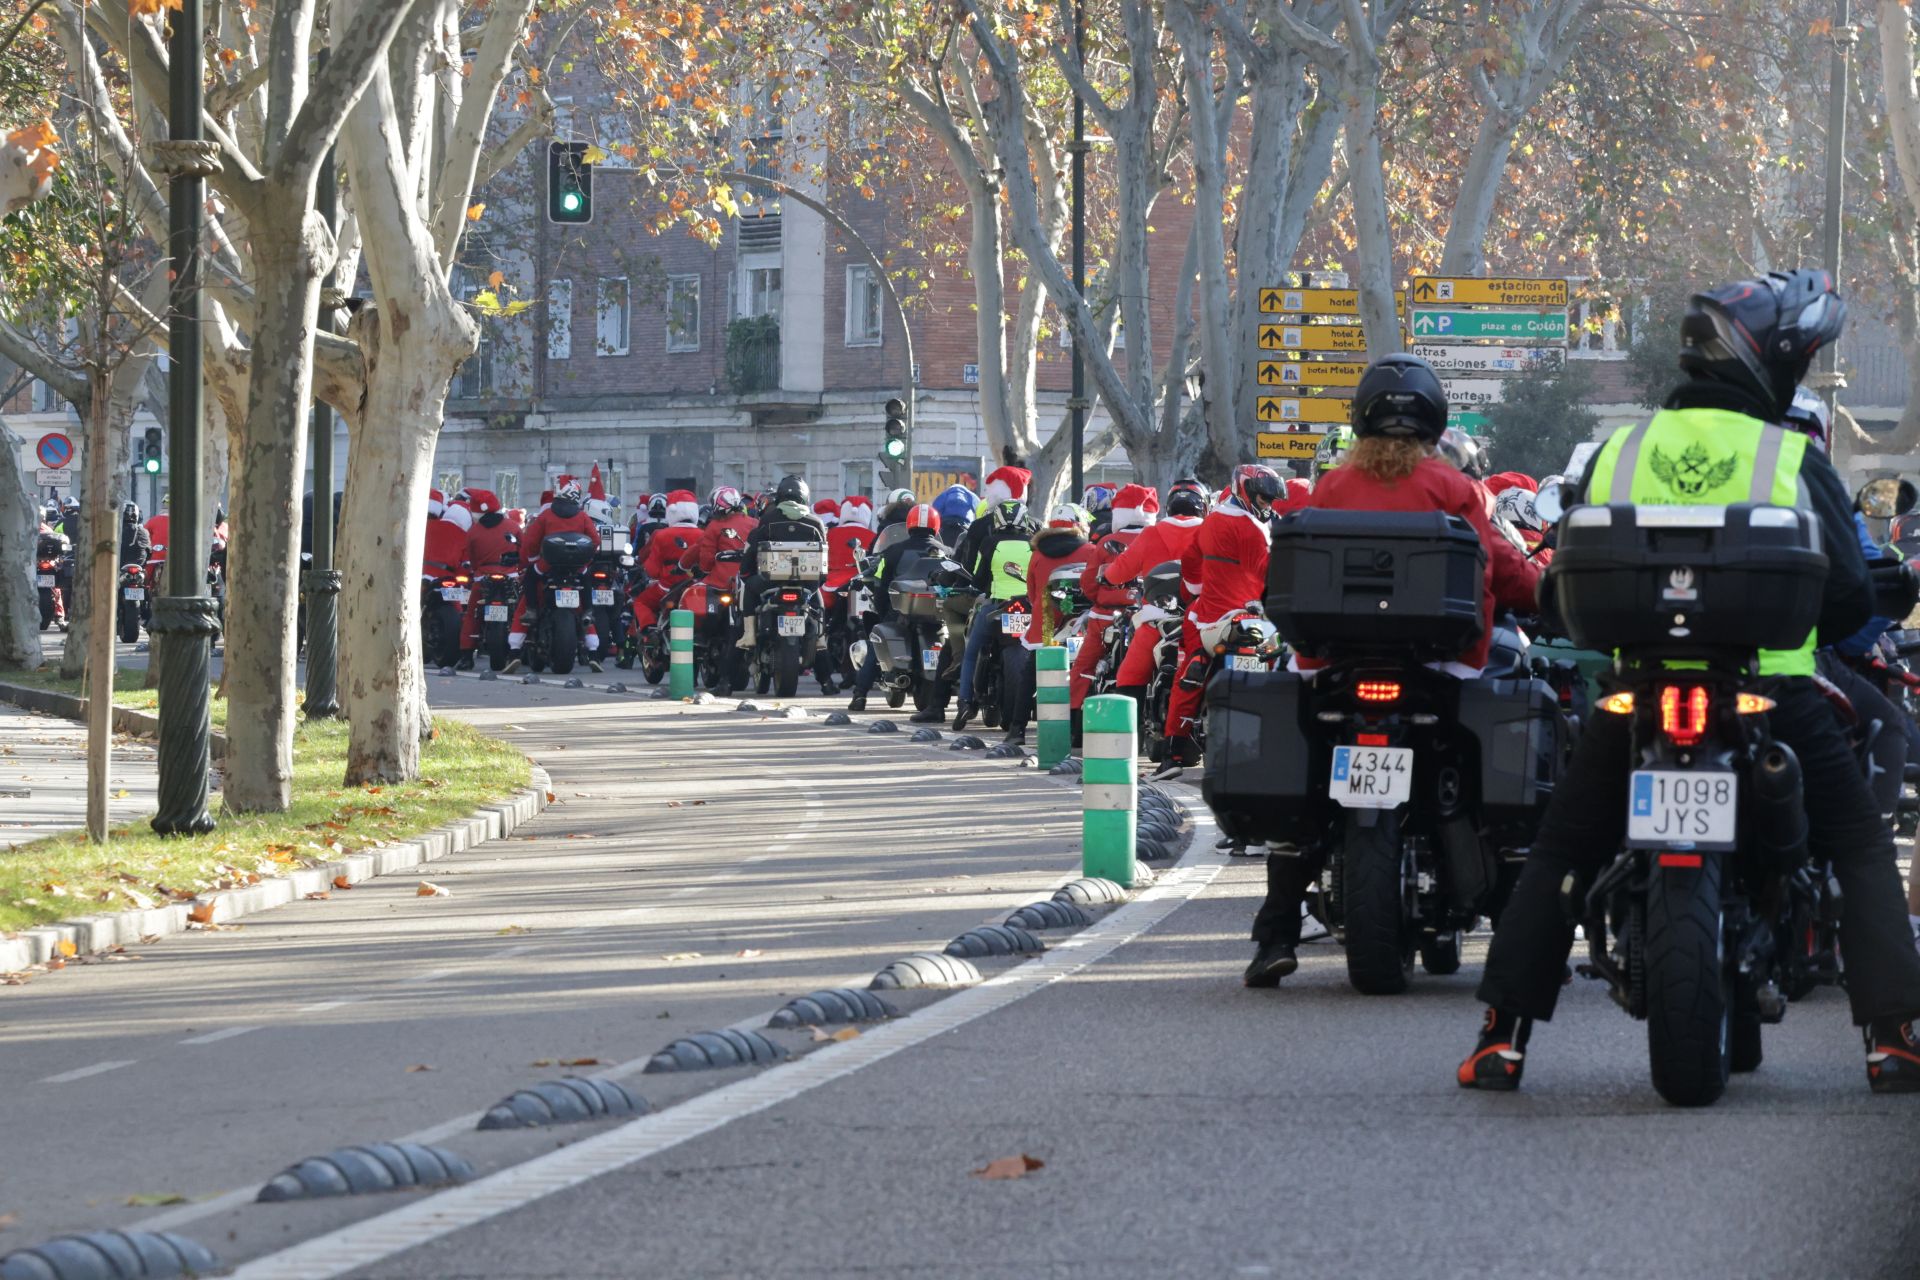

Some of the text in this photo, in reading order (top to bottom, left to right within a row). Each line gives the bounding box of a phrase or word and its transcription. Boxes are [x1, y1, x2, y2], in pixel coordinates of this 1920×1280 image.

[1488, 281, 1564, 291] estación de
[1329, 295, 1355, 306] hotel
[1500, 293, 1565, 303] ferrocarril
[1438, 316, 1452, 332] P
[1511, 322, 1522, 331] de
[1527, 320, 1564, 331] Colón
[1331, 330, 1354, 338] hotel
[1332, 339, 1355, 348] hotel
[1415, 347, 1447, 357] otras
[1424, 357, 1487, 369] ecciones
[1307, 367, 1328, 375] hotel
[1260, 439, 1317, 451] hotel Parq
[1351, 752, 1406, 773] 4344
[1349, 774, 1391, 795] MRJ
[1659, 778, 1729, 805] 1098
[1654, 808, 1710, 835] JYS
